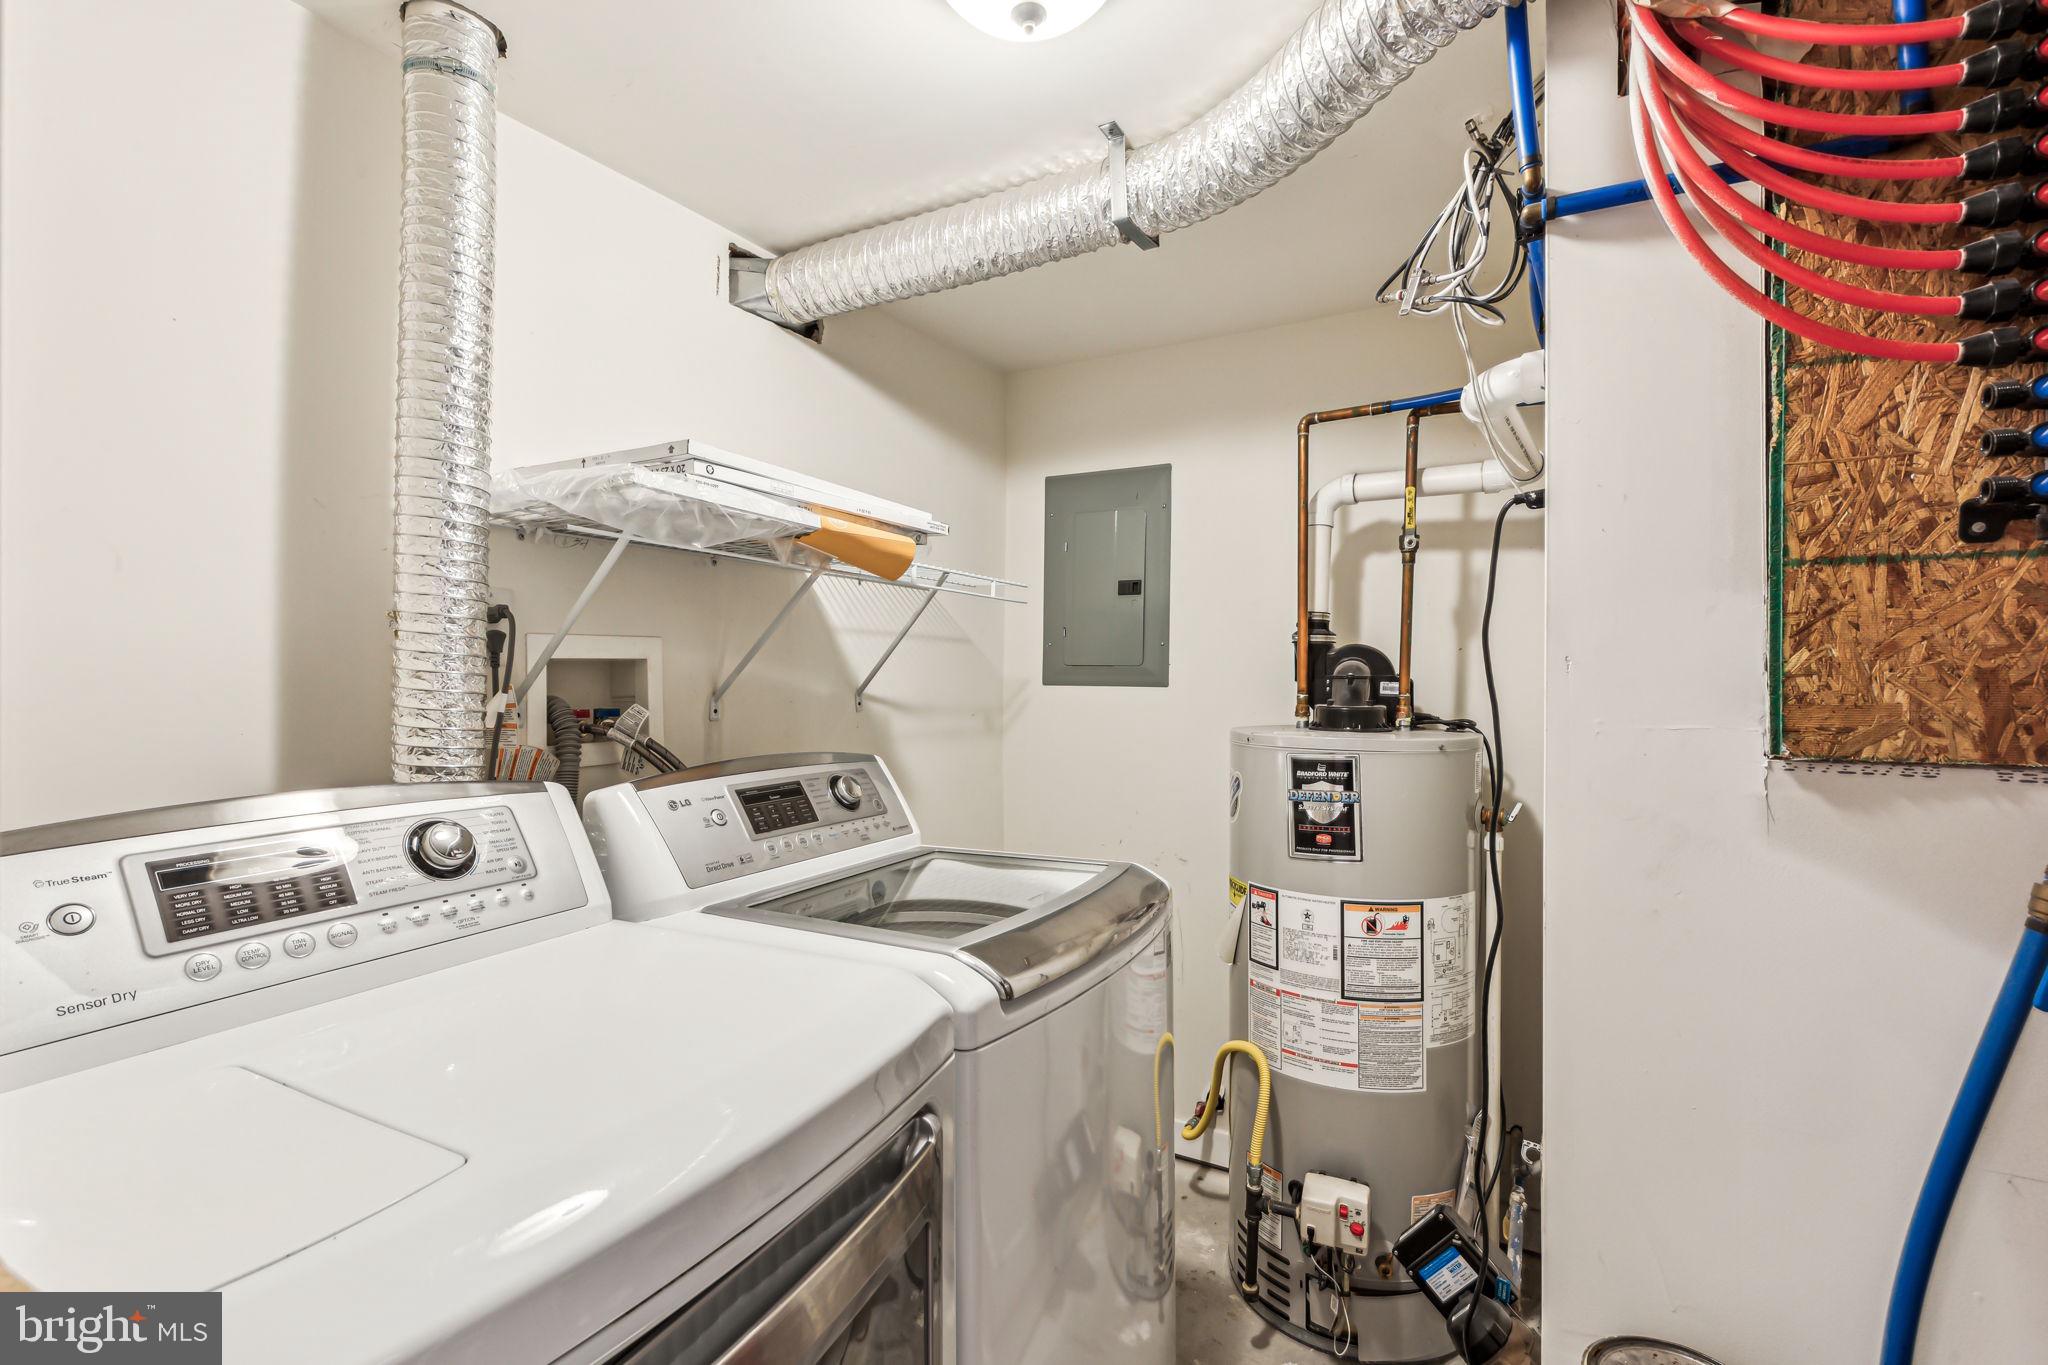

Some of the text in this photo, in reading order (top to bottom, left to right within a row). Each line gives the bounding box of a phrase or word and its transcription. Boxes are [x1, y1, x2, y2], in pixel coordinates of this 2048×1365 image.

[1288, 789, 1360, 804] DEFENDER
[679, 799, 692, 807] LG
[176, 858, 210, 868] PROCESSING
[331, 930, 354, 940] SIGNAL
[241, 953, 268, 963] CONTROL
[195, 960, 211, 968] DRY
[193, 965, 216, 974] LEVEL
[56, 990, 137, 1017] Sensor Dry
